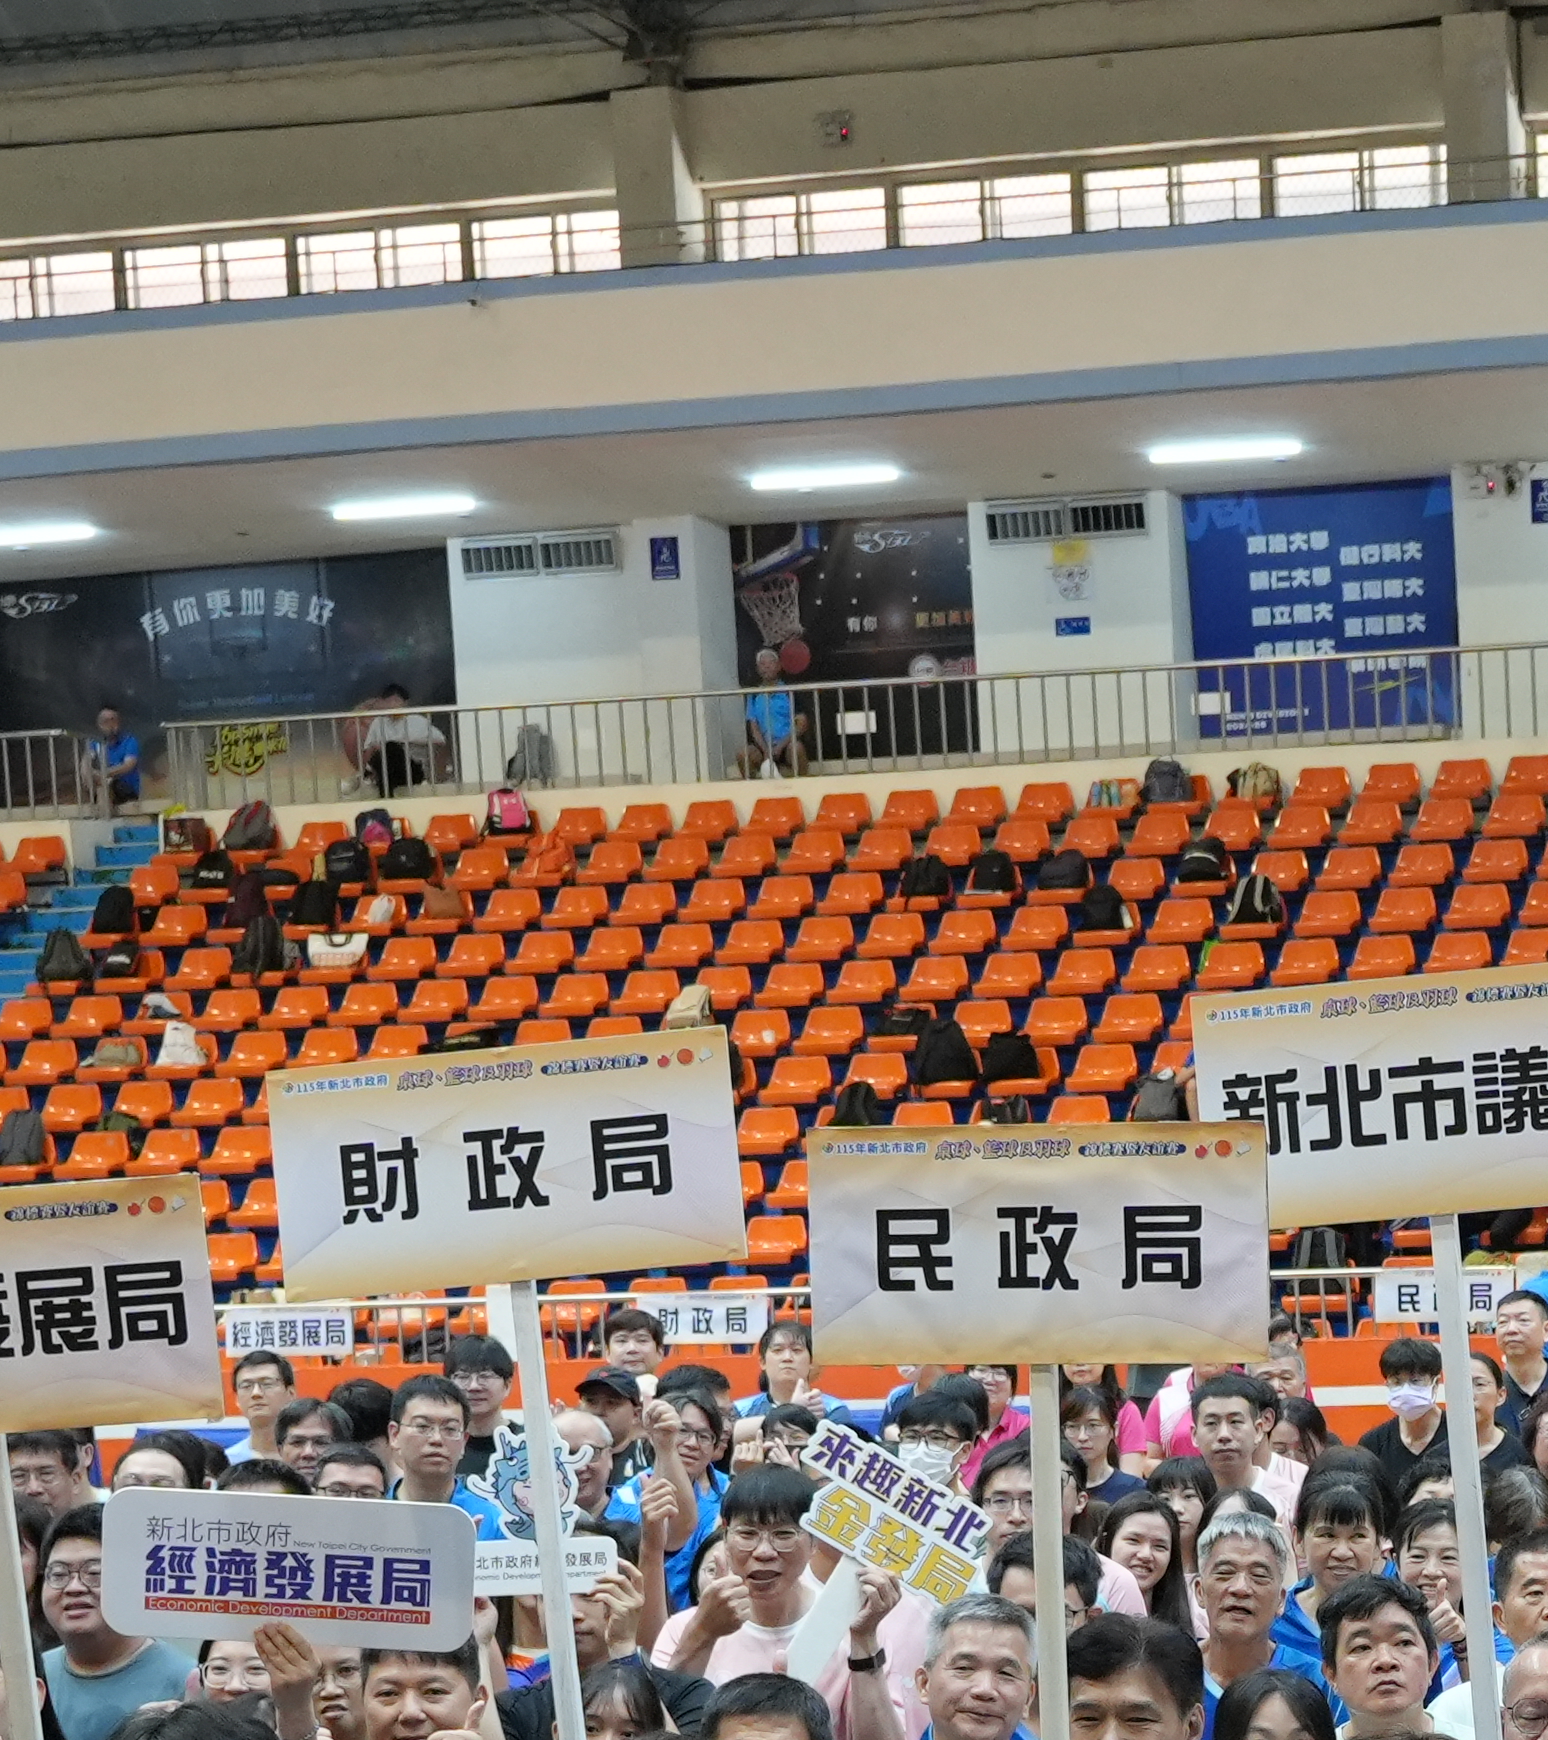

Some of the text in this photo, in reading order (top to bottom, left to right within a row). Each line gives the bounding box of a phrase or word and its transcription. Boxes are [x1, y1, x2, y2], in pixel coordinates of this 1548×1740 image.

[140, 587, 335, 641] 有你更加美好
[1219, 1001, 1311, 1022] 115年新北市政府
[836, 1141, 927, 1156] 115年新北市政府
[339, 1113, 674, 1225] 財政局
[875, 1205, 1204, 1292] 民政局
[1398, 1283, 1492, 1312] 民局
[232, 1312, 347, 1348] 經濟發展局
[659, 1306, 748, 1335] 財政局
[812, 1430, 989, 1555] 來趣新北
[146, 1515, 292, 1548] 新北市政府
[317, 1540, 347, 1552] Taipei
[370, 1543, 431, 1555] Government
[145, 1544, 431, 1608] 經濟發展局
[149, 1599, 427, 1624] Economic Development Department
